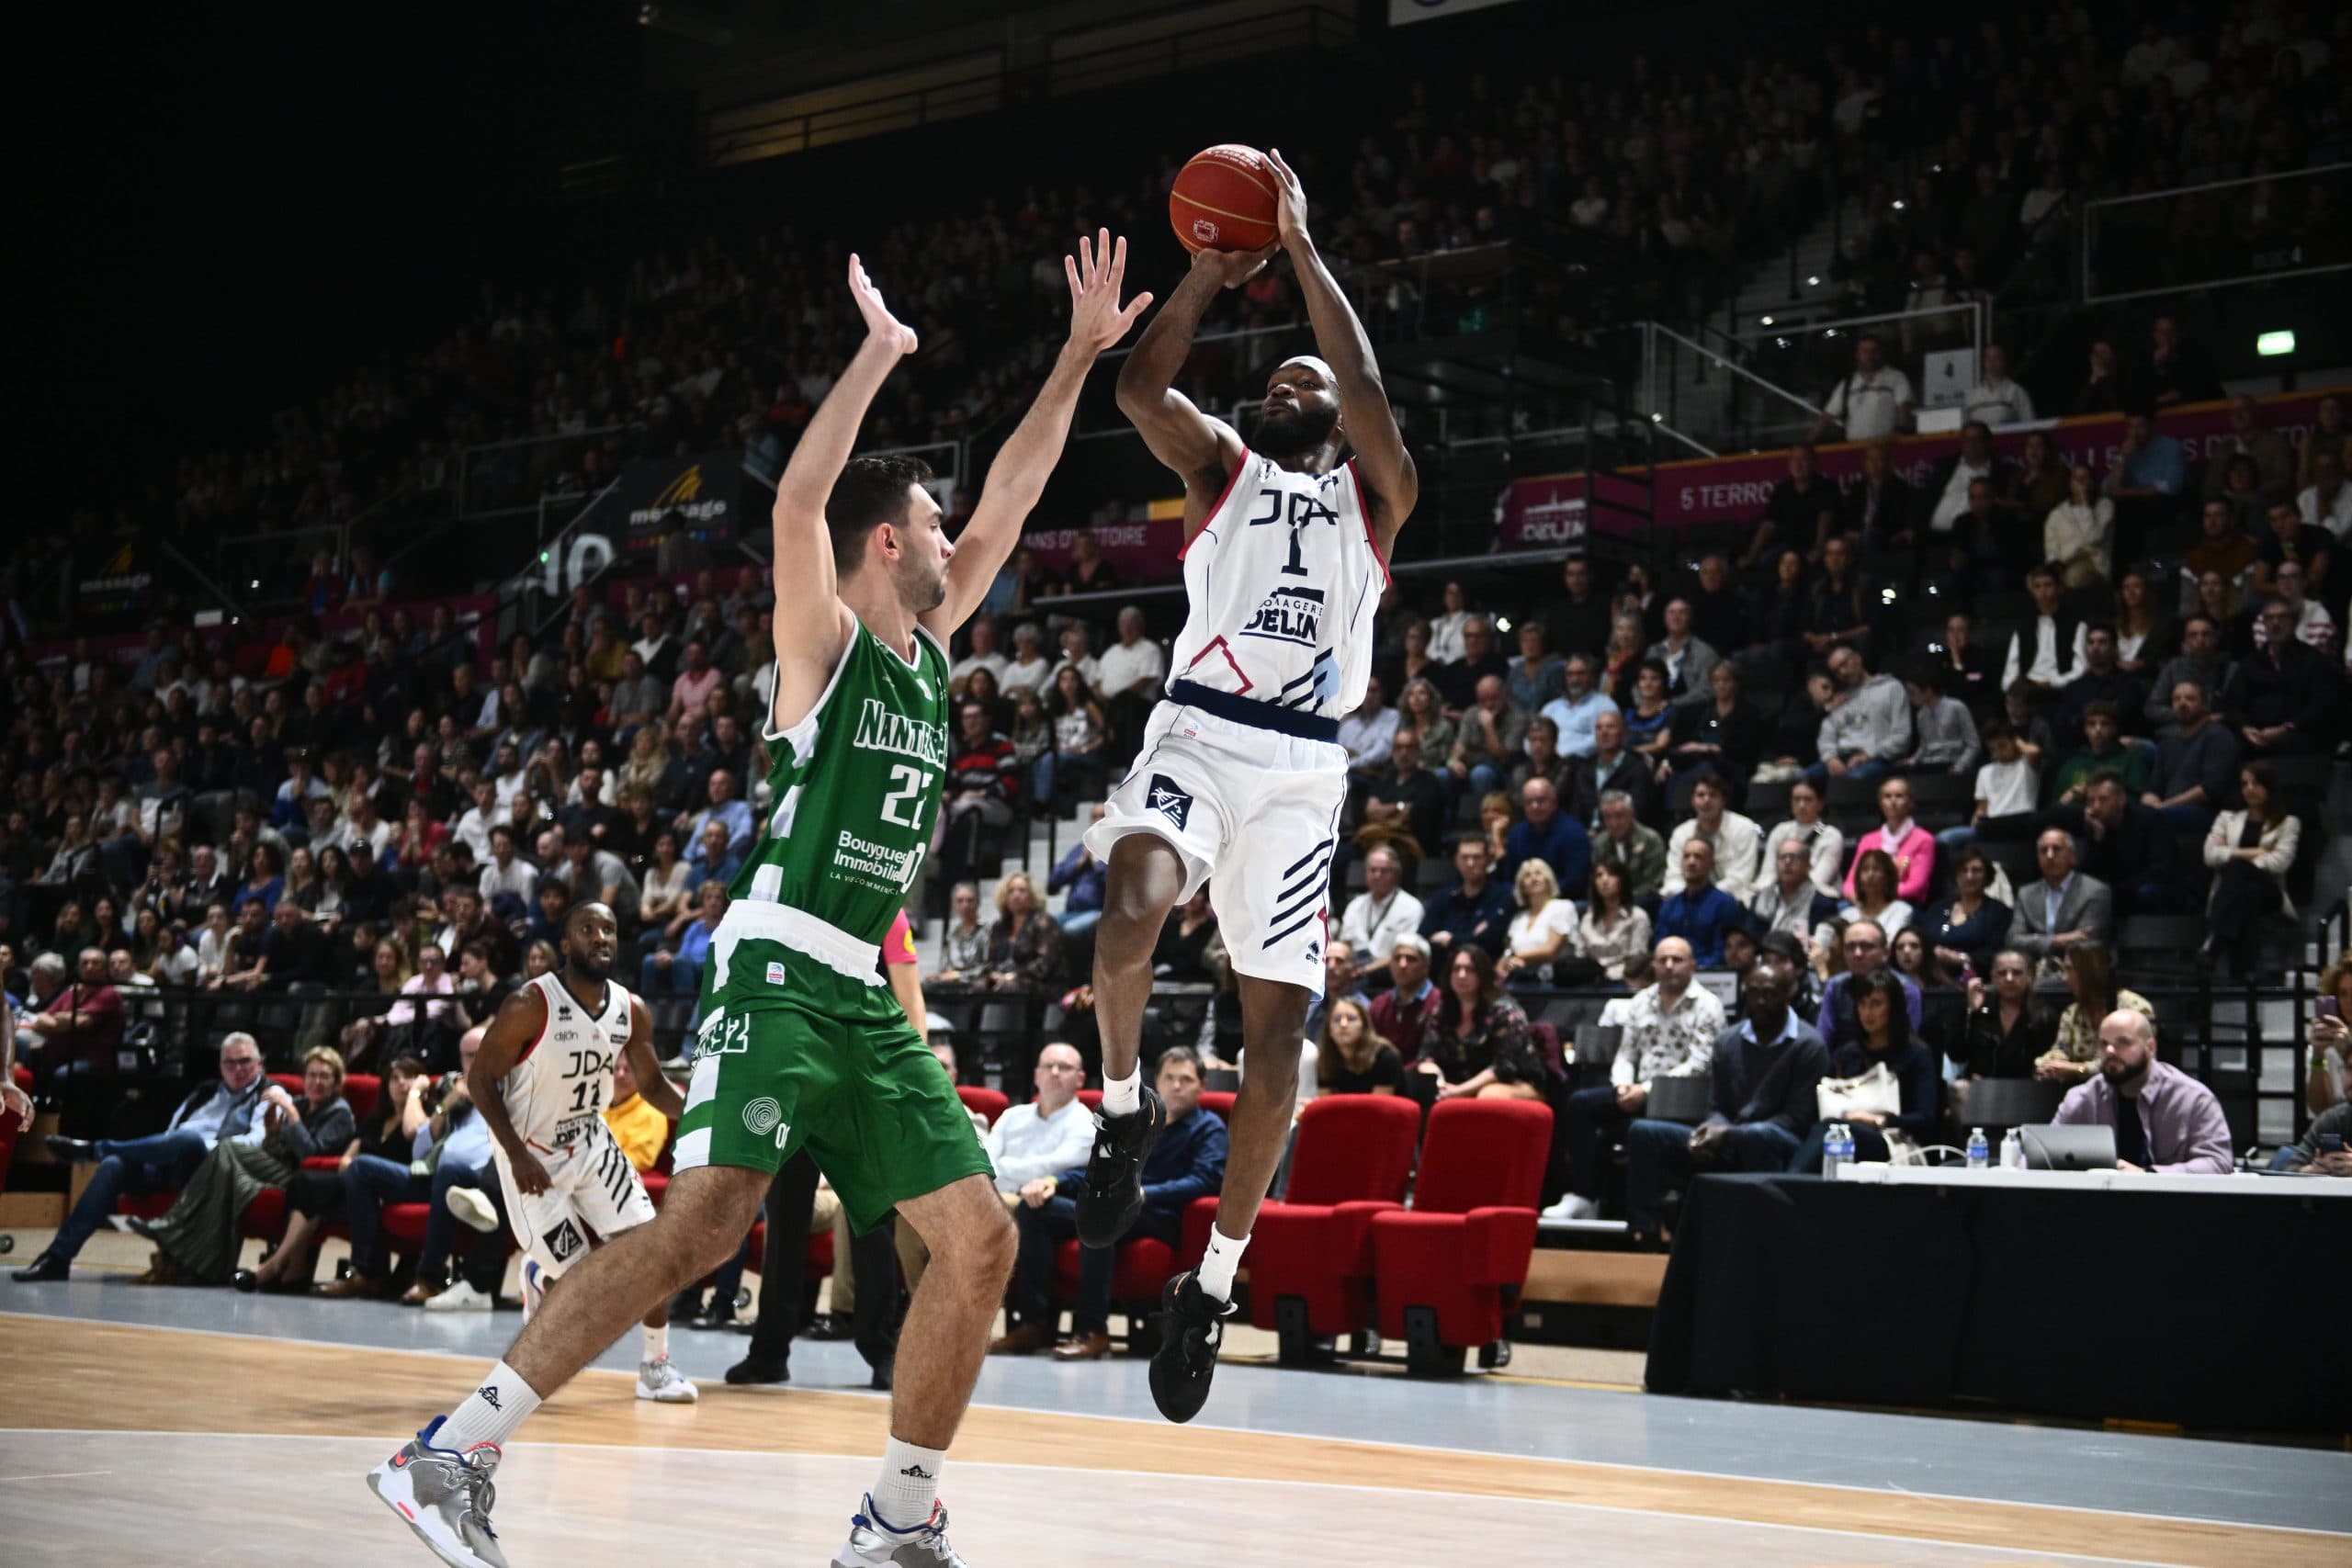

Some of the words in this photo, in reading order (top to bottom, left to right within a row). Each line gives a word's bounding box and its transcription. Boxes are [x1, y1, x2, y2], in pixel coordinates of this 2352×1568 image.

[1250, 489, 1339, 527] JDA
[1680, 491, 1694, 511] 5
[1700, 479, 1776, 507] TERRO
[1281, 527, 1308, 577] 1
[830, 872, 842, 880] LA
[561, 1049, 614, 1078] JDA
[570, 1078, 600, 1111] 11
